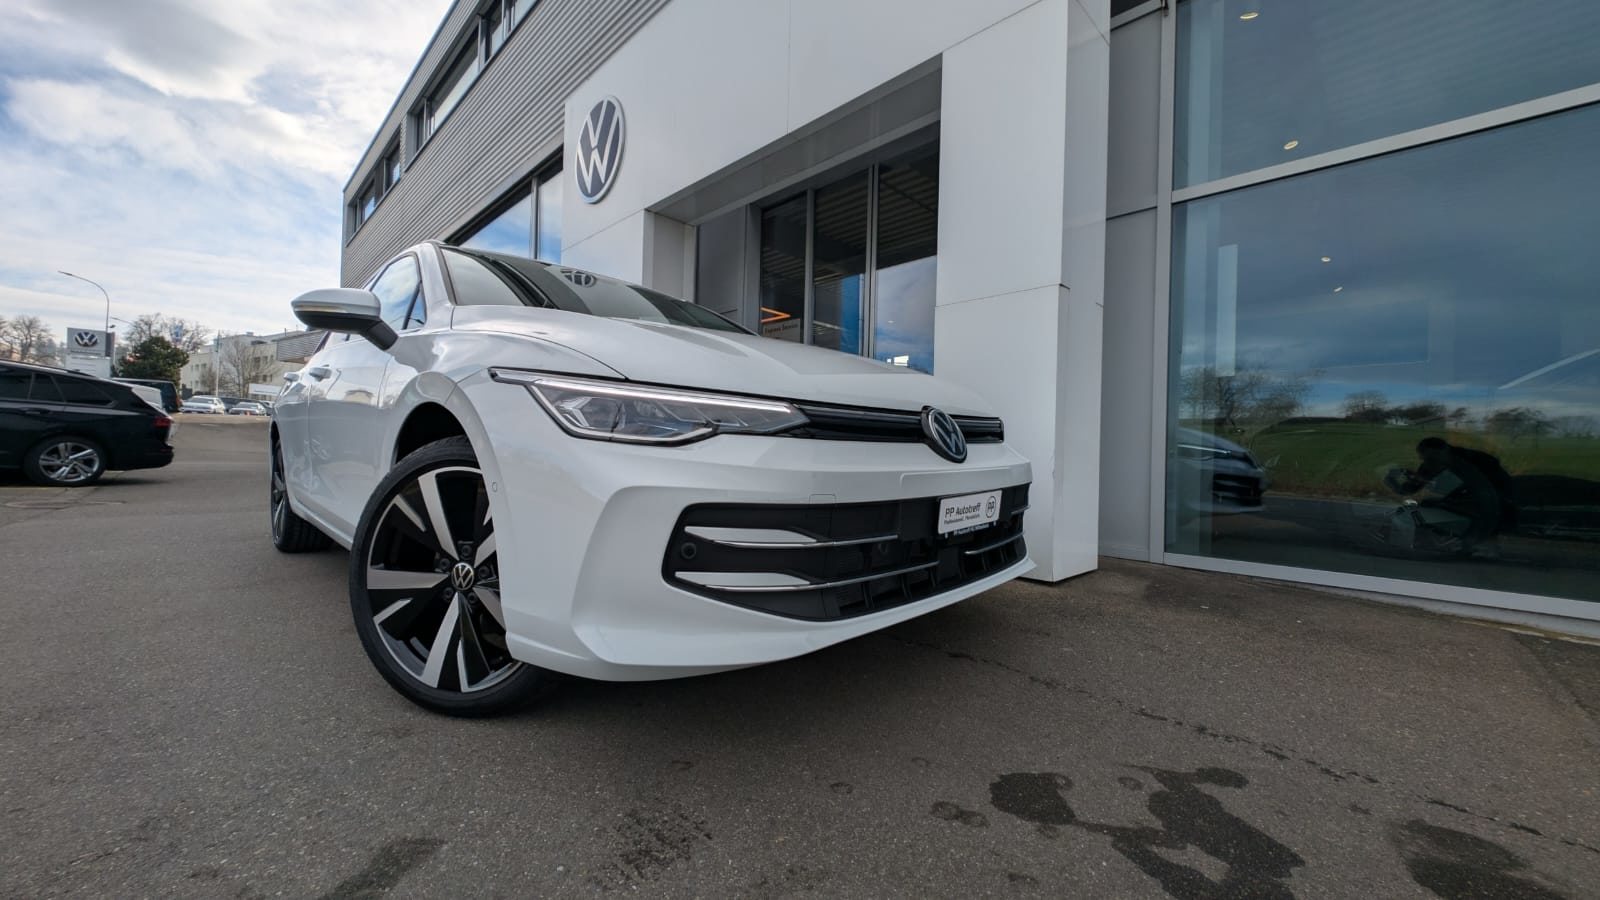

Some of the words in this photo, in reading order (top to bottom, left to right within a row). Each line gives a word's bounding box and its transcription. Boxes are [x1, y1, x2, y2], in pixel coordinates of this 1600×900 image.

[576, 97, 622, 198] VW
[945, 507, 955, 518] PP
[956, 502, 981, 515] Autotreff
